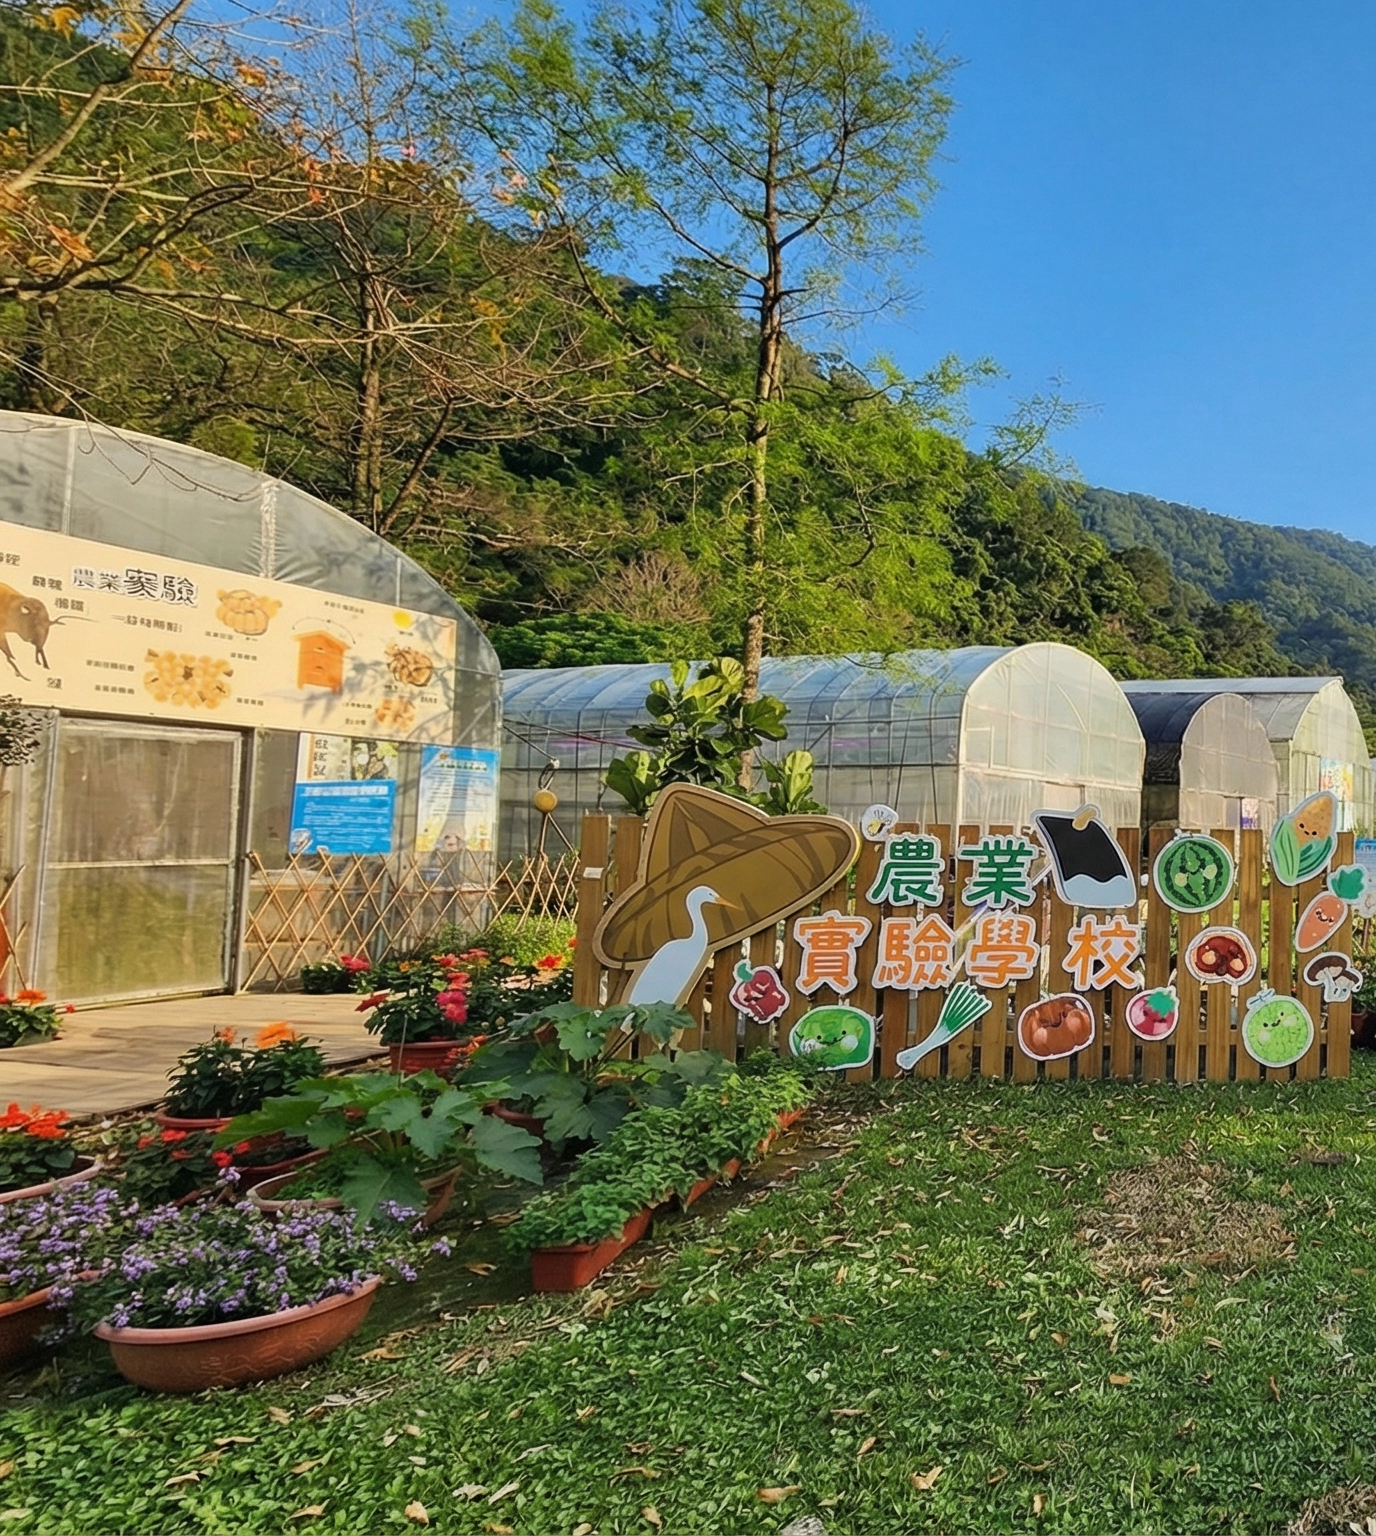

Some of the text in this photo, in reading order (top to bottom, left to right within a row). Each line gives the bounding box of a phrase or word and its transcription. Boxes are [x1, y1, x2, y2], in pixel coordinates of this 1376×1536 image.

[871, 838, 1034, 904] 農業
[799, 916, 1137, 988] 實驗學校
